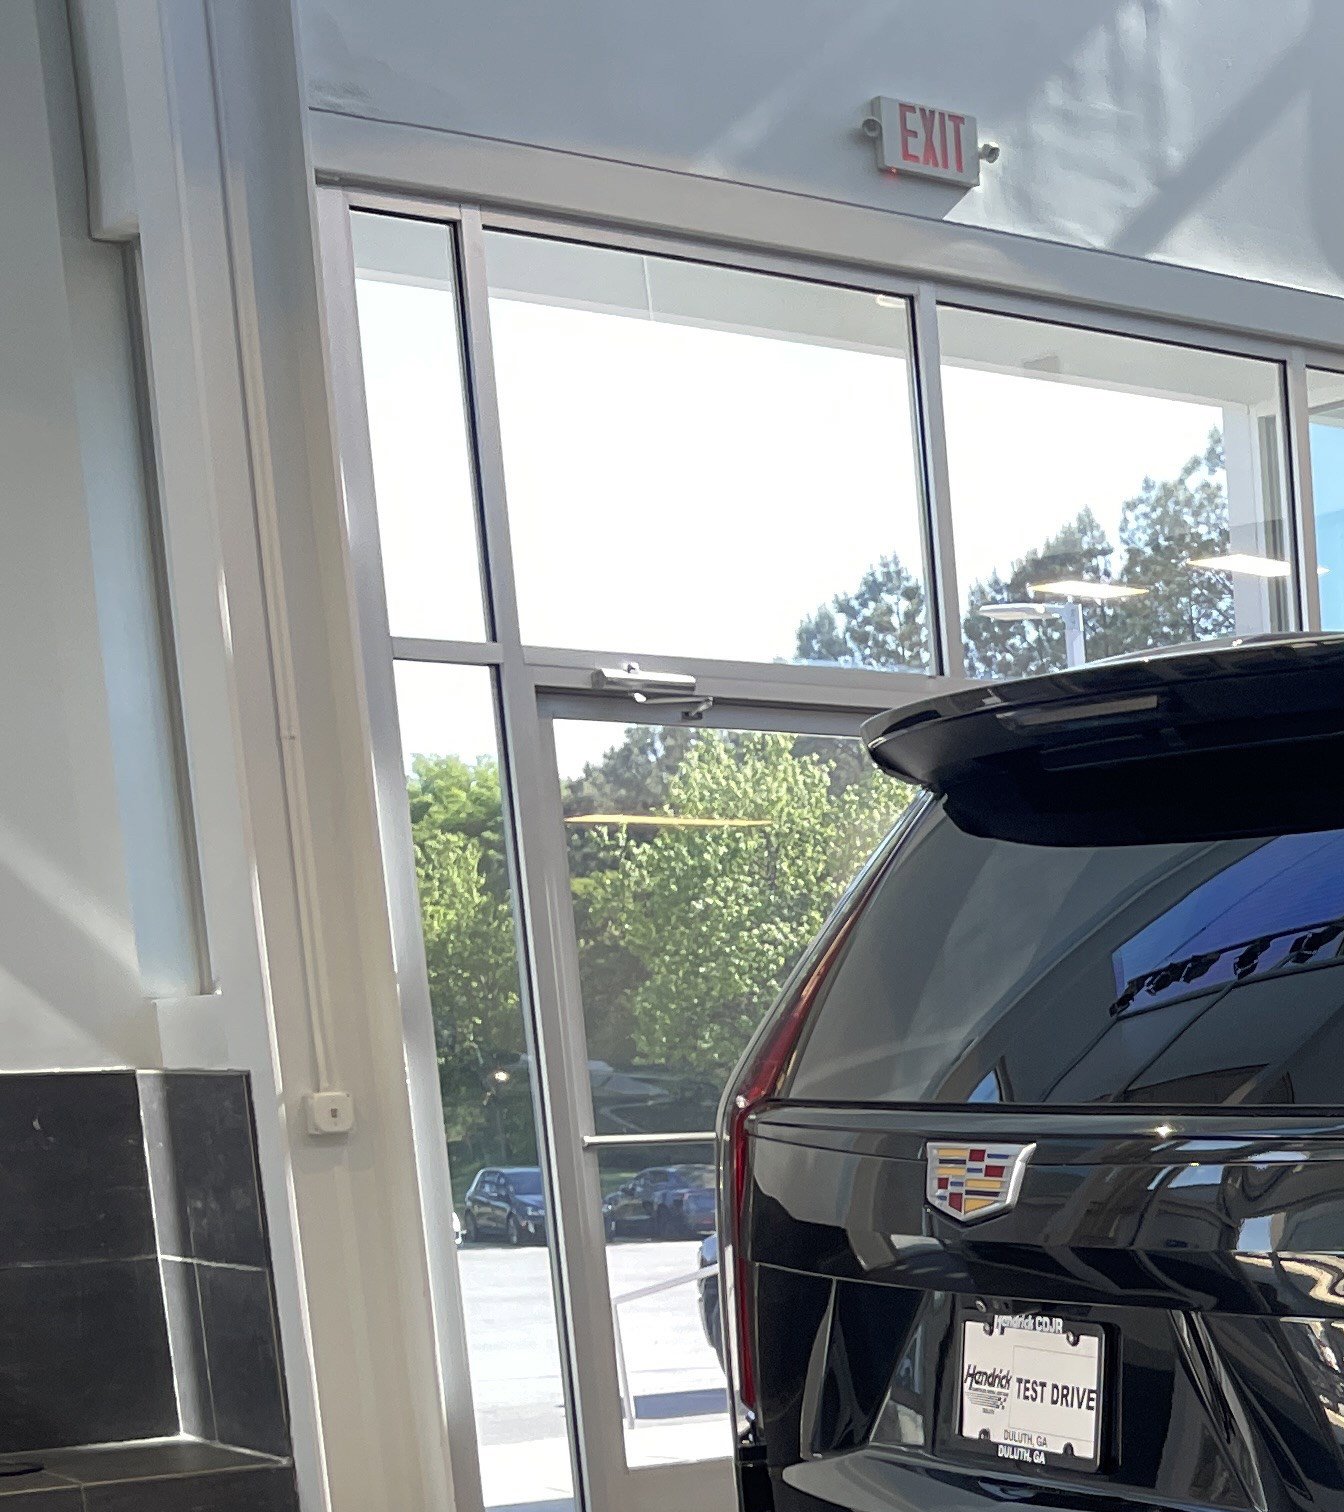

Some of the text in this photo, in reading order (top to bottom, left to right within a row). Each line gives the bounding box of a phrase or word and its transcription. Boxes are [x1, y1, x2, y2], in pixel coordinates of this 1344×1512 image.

[898, 102, 965, 173] EXIT
[1035, 1316, 1064, 1334] CDJR
[964, 1363, 1013, 1391] Hendrick
[1016, 1377, 1097, 1411] TEST DRIVE
[1036, 1435, 1048, 1447] GA
[1033, 1451, 1046, 1465] GA
